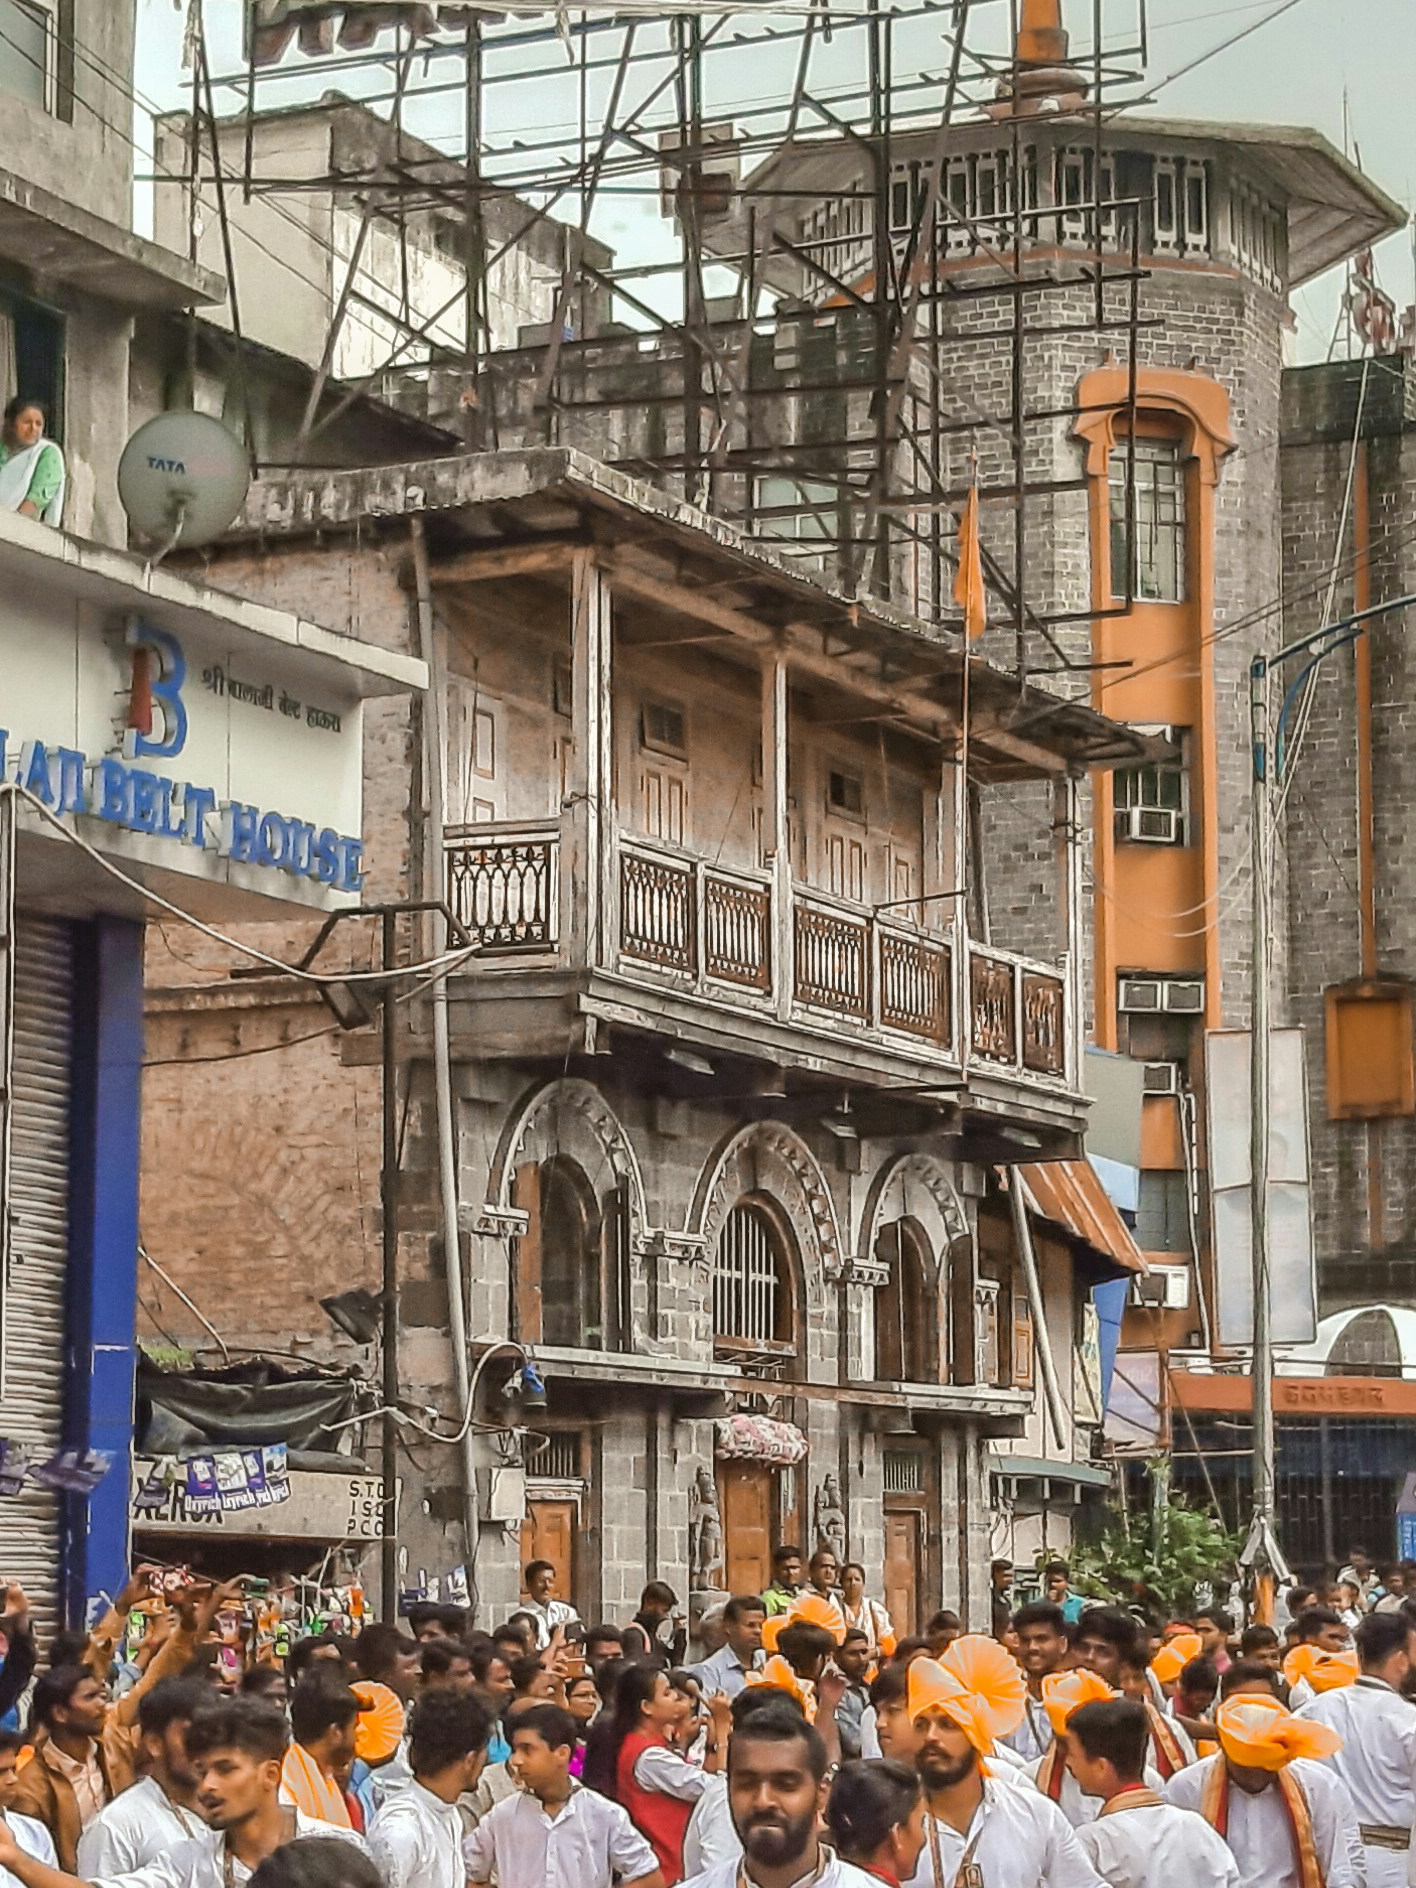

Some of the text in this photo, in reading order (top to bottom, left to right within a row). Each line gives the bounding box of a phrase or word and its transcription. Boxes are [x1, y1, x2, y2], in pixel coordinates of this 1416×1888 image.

[147, 456, 186, 474] TATA
[98, 757, 217, 849] BELT
[226, 799, 364, 892] HOUSE
